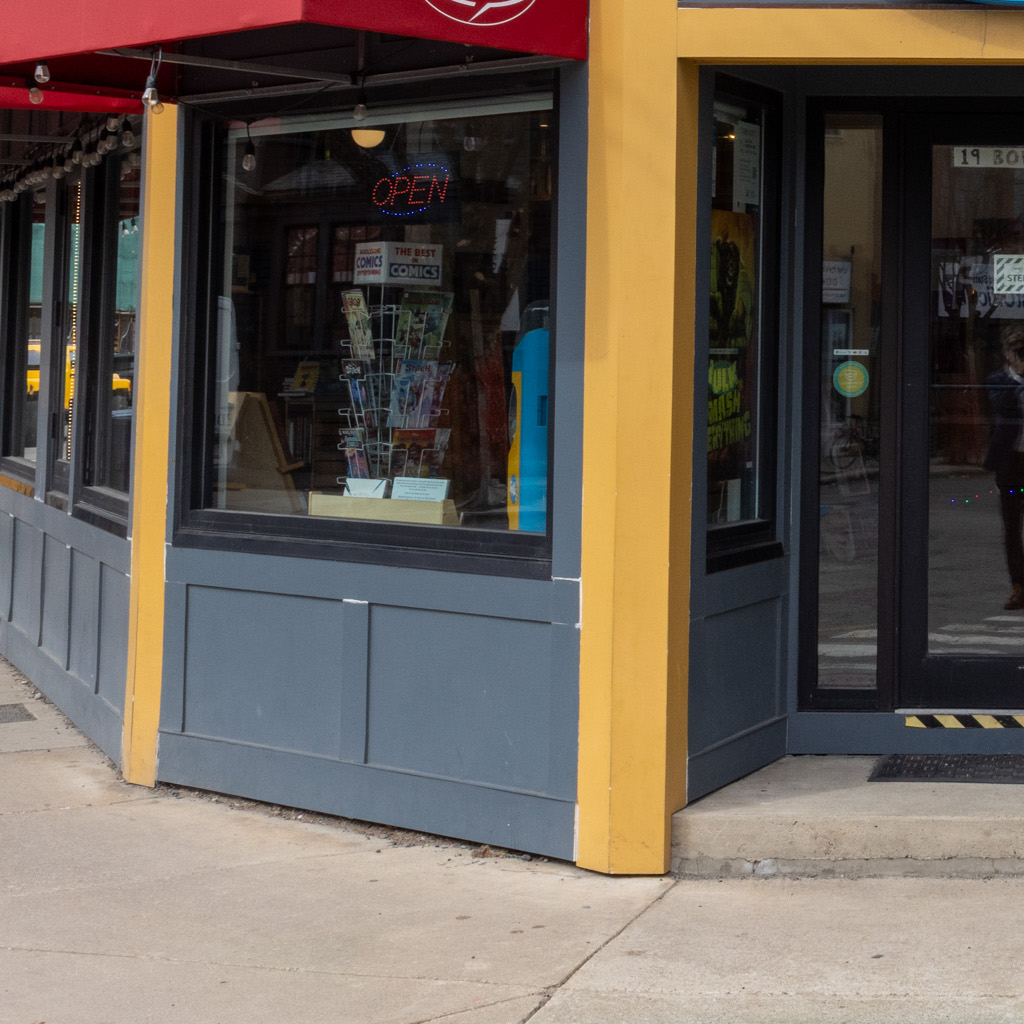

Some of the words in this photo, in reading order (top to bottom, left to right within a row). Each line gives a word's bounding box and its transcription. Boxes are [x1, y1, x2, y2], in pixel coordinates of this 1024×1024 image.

[961, 148, 980, 165] 19
[372, 173, 450, 206] OPEN
[395, 247, 412, 256] THE
[414, 248, 436, 258] BEST
[356, 255, 383, 269] COMICS
[390, 264, 438, 279] COMICS
